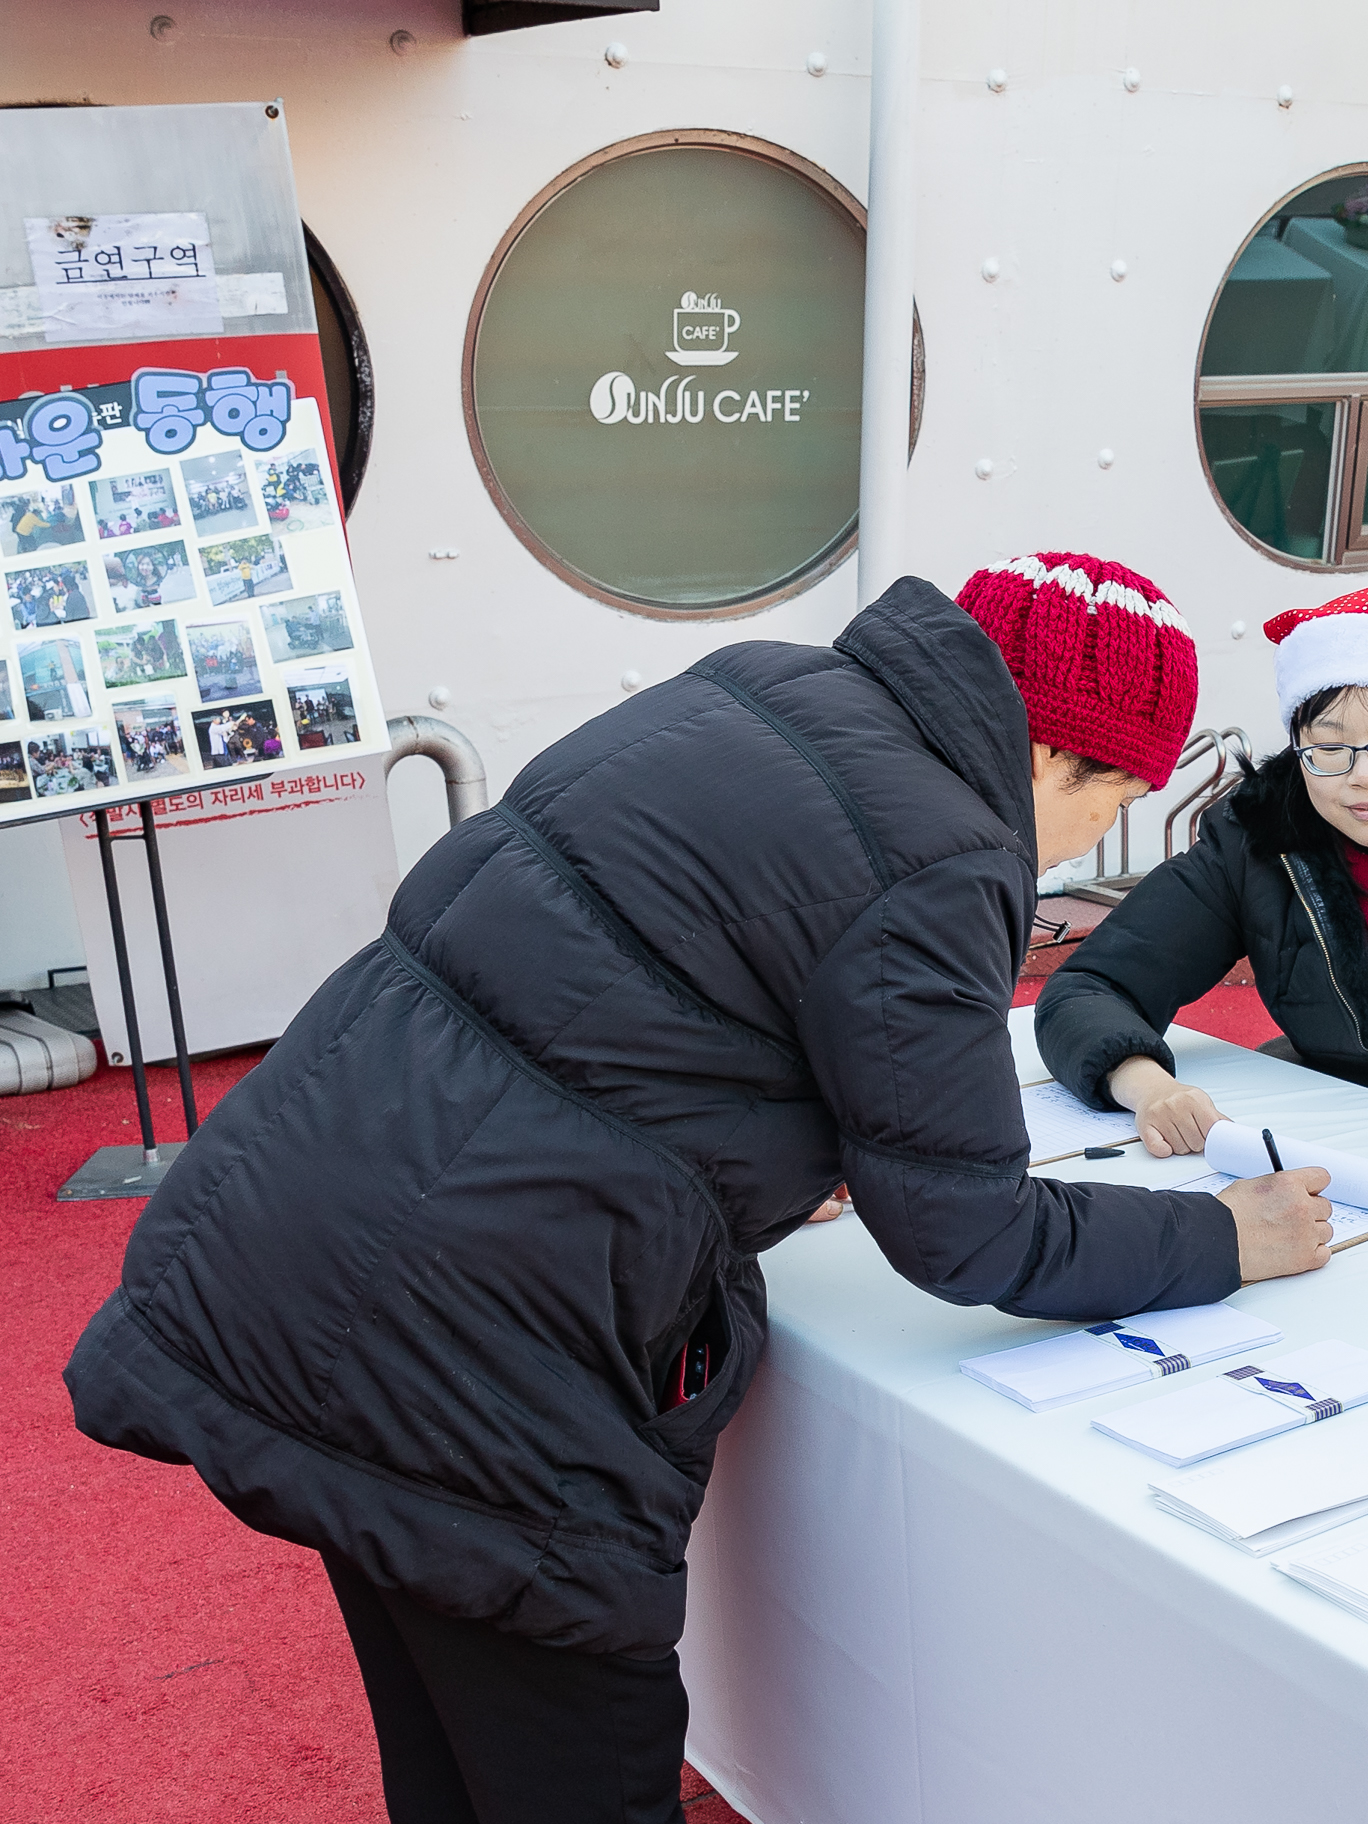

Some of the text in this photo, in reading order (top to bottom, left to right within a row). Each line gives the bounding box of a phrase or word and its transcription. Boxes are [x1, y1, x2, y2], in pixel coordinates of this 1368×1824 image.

[54, 243, 201, 282] 금연구역
[133, 368, 292, 454] 동행
[211, 779, 264, 808] 자리세
